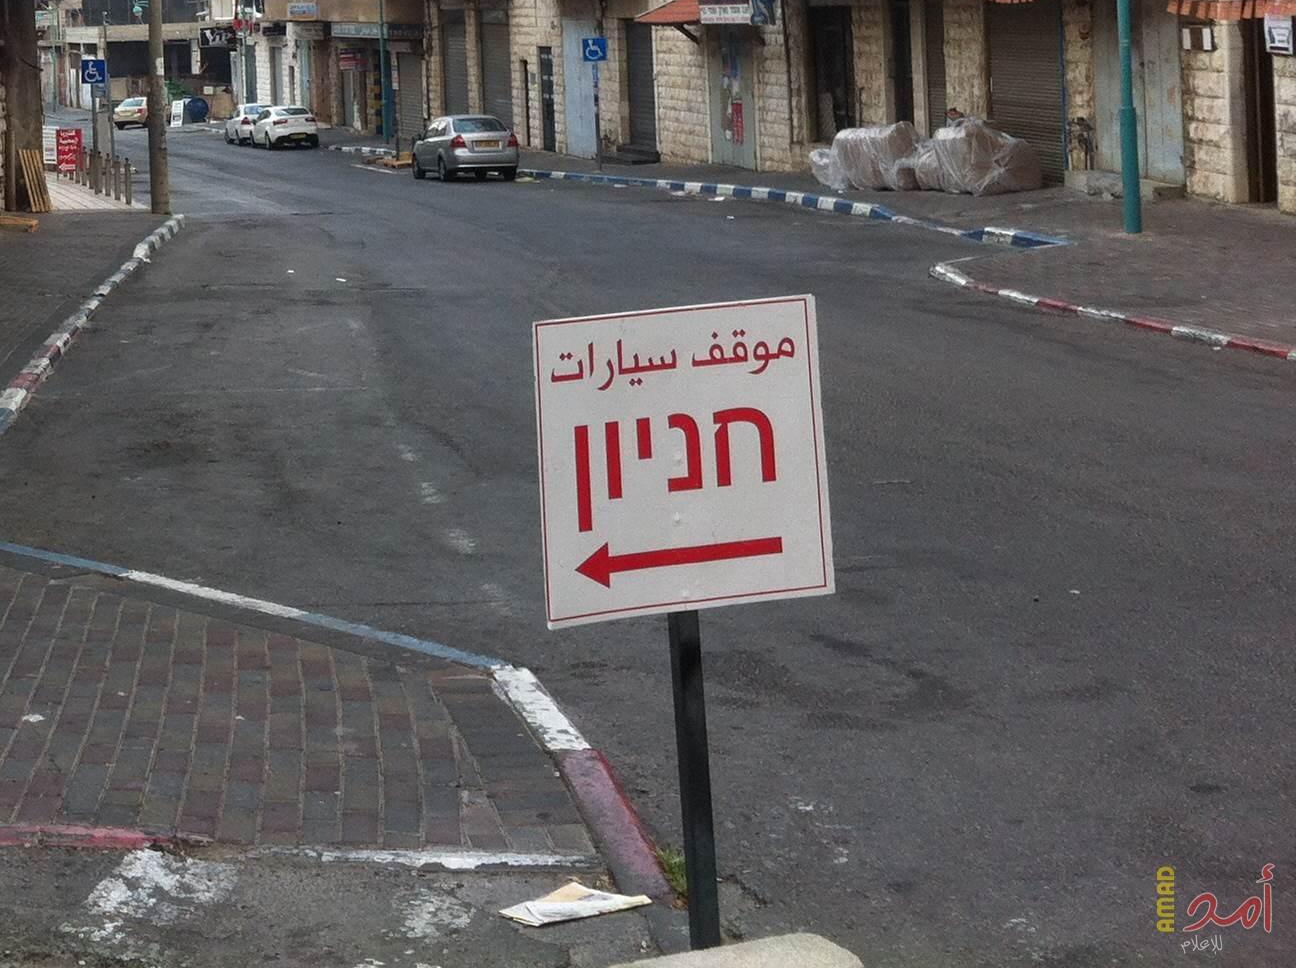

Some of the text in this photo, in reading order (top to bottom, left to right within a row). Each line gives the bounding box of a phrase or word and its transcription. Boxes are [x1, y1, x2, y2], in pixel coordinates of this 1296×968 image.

[550, 329, 796, 391] موقف سيارات
[574, 407, 777, 533] חניון
